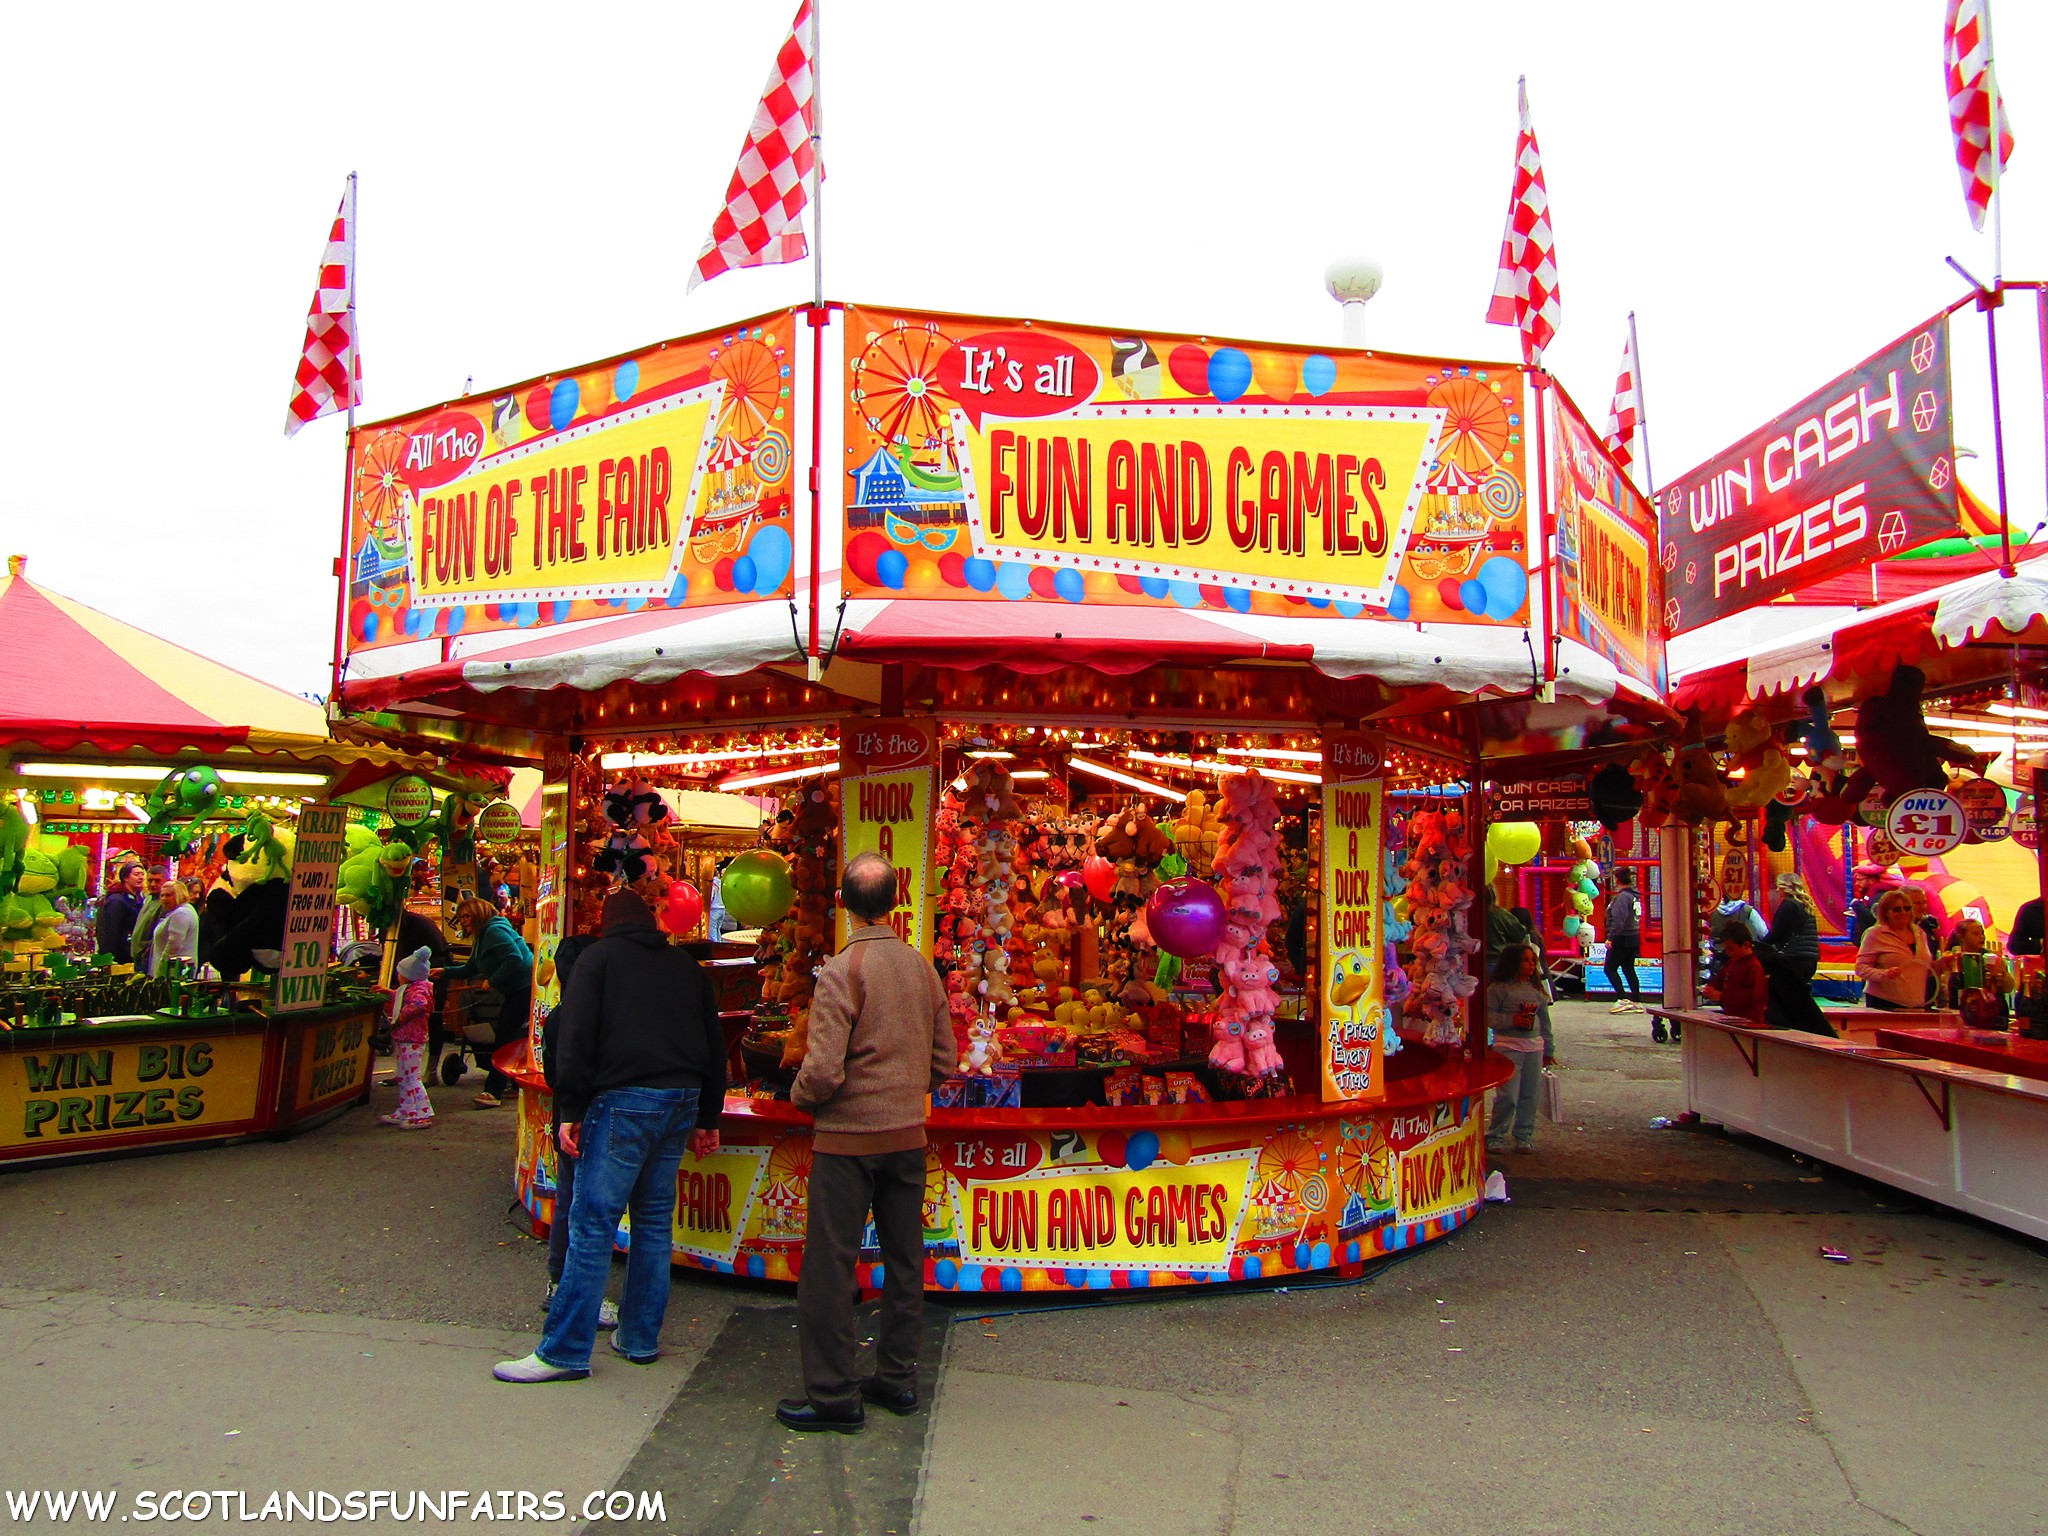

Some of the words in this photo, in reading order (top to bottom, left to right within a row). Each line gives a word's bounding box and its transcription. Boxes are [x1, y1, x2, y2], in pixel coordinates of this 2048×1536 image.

[960, 346, 1024, 395] It's
[1034, 355, 1075, 398] all
[405, 432, 434, 471] All
[436, 427, 479, 462] The
[1689, 457, 1753, 534] WIN
[1762, 370, 1900, 494] CASH
[989, 430, 1096, 545] FUN
[1106, 440, 1214, 549] AND
[1227, 447, 1389, 557] GAMES
[421, 487, 476, 588] FUN
[484, 478, 522, 579] OF
[530, 464, 588, 570] THE
[596, 446, 673, 561] FAIR
[1713, 481, 1868, 599] PRIZES
[1579, 505, 1600, 611] FUN
[1611, 541, 1627, 630] THE
[856, 731, 884, 755] It's
[888, 734, 920, 755] the
[1333, 743, 1352, 765] It's
[1354, 748, 1375, 767] the
[859, 781, 914, 825] HOOK
[1503, 783, 1532, 794] WIN
[1537, 781, 1586, 794] CASH
[1334, 789, 1371, 830] HOOK
[1500, 800, 1524, 812] OR
[1528, 798, 1590, 811] PRIZES
[1904, 799, 1948, 811] ONLY
[302, 810, 344, 834] CRAZY
[1894, 813, 1957, 837] £1
[1980, 828, 2006, 836] £1.00
[296, 840, 341, 863] FROGGIT
[1348, 831, 1358, 869] A
[1905, 837, 1917, 849] A
[1922, 838, 1947, 849] GO
[291, 894, 312, 911] FROG
[314, 894, 326, 910] ON
[326, 897, 333, 910] A
[1335, 868, 1370, 908] DUCK
[312, 916, 329, 932] PAD
[1333, 910, 1371, 950] GAME
[293, 941, 320, 969] TO
[281, 974, 324, 1005] WIN
[1328, 1020, 1341, 1045] A
[1343, 1020, 1378, 1043] Prize
[23, 1050, 114, 1092] WIN
[137, 1042, 213, 1082] BIG
[1333, 1045, 1371, 1070] Every
[309, 1055, 357, 1100] PRIZES
[1336, 1070, 1370, 1091] Time
[24, 1086, 204, 1138] PRIZES
[1390, 1117, 1406, 1140] All
[1407, 1115, 1430, 1136] The
[954, 1140, 994, 1169] It's
[1001, 1142, 1027, 1167] all
[1402, 1153, 1430, 1213] FUN
[1430, 1146, 1446, 1203] OF
[1447, 1140, 1466, 1196] THE
[677, 1168, 732, 1233] FAIR
[971, 1186, 1038, 1253] FUN
[1047, 1185, 1115, 1250] AND
[1123, 1183, 1229, 1247] GAMES
